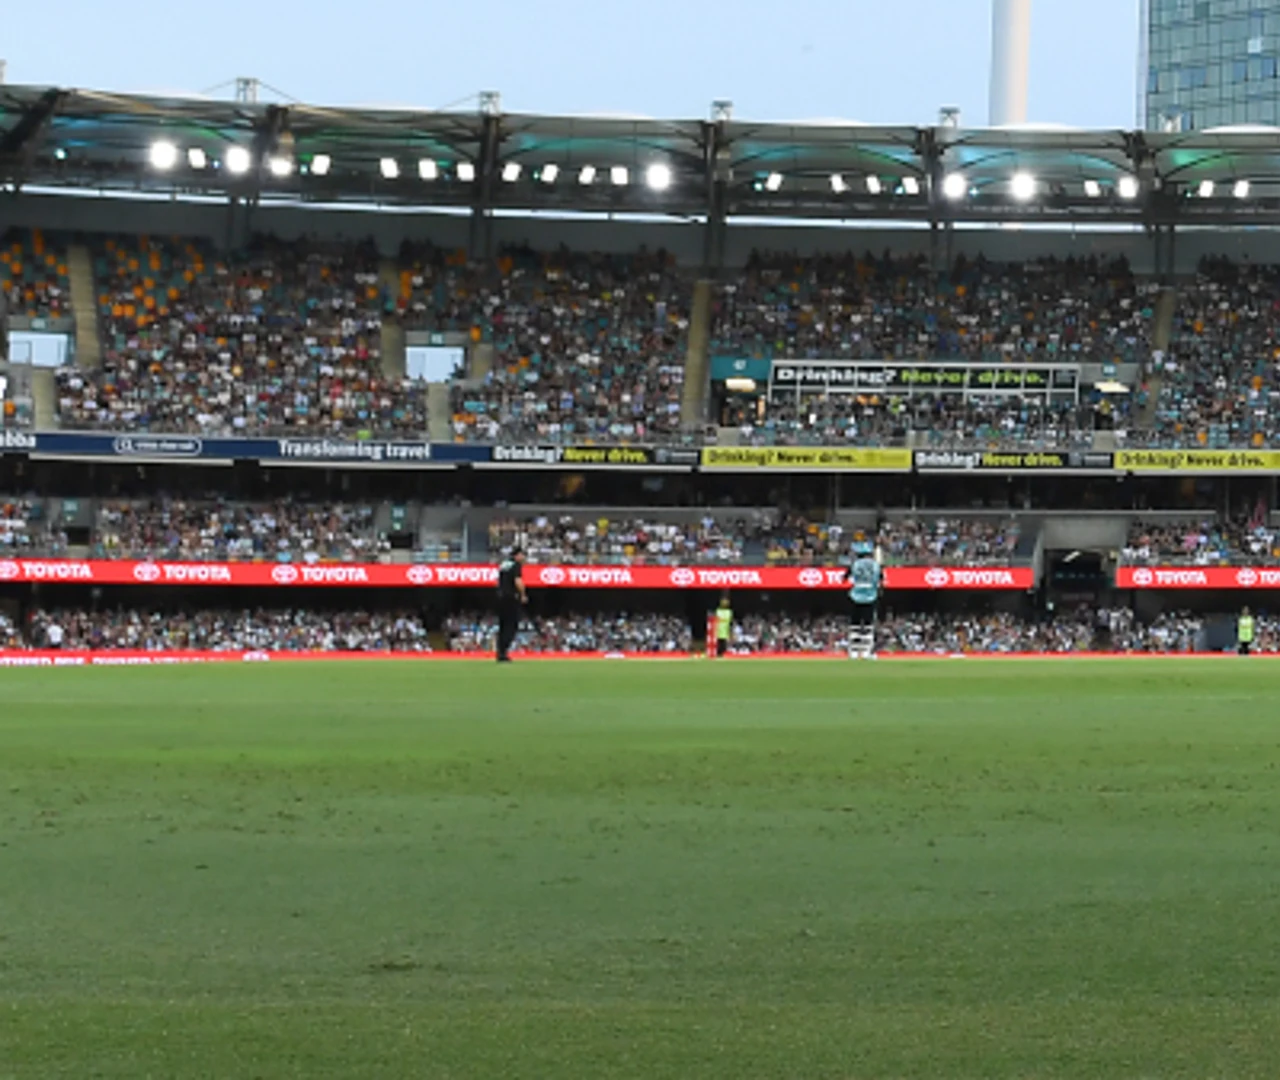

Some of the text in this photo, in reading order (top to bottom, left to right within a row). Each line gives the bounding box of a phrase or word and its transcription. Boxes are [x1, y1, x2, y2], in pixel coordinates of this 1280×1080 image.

[777, 368, 897, 385] Drinking?
[279, 439, 431, 462] Transforming travel
[494, 445, 563, 463] Drinking?
[709, 449, 772, 468] Drinking?
[915, 452, 980, 470] Drinking?
[1121, 452, 1184, 470] Drinking?
[23, 563, 91, 577] TOYOTA
[164, 565, 230, 580] TOYOTA
[301, 568, 367, 581] TOYOTA
[436, 568, 499, 581] TOYOTA
[569, 569, 631, 582] TOYOTA
[698, 571, 760, 584] TOYOTA
[952, 571, 1012, 584] TOYOTA
[1155, 571, 1206, 584] TOYOTA
